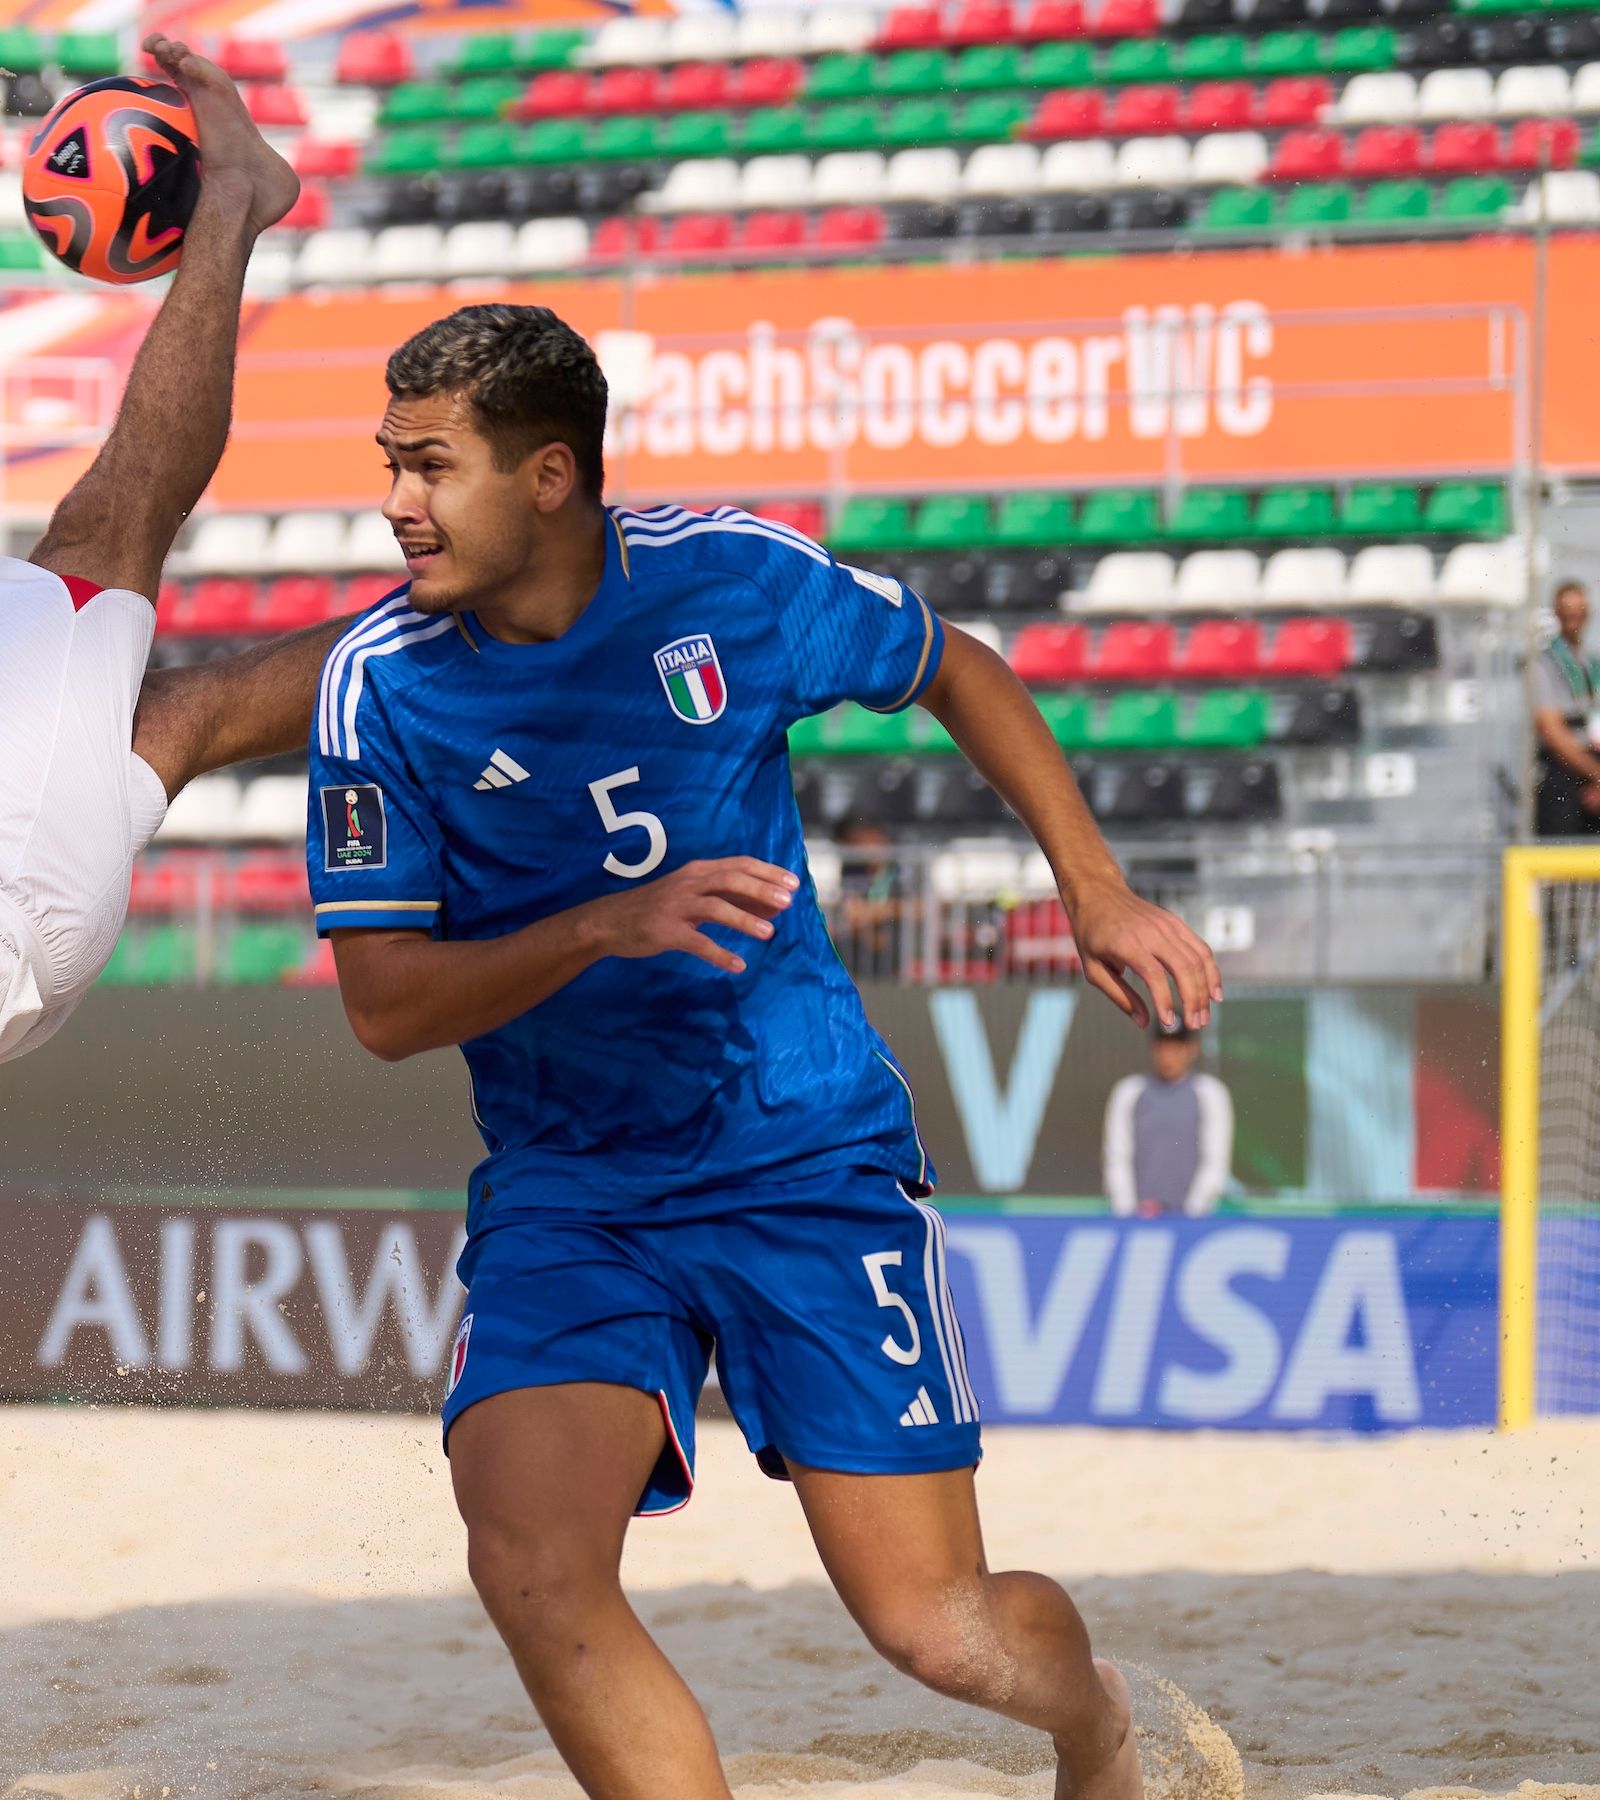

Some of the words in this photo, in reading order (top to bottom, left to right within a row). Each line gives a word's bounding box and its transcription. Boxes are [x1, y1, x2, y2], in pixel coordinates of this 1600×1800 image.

[659, 640, 711, 671] ITALIA
[337, 850, 352, 859] UAE
[352, 849, 372, 857] 2024
[587, 765, 668, 879] 5
[36, 1212, 468, 1378] AIRW
[861, 1251, 922, 1367] 5
[945, 1228, 1423, 1423] VISA
